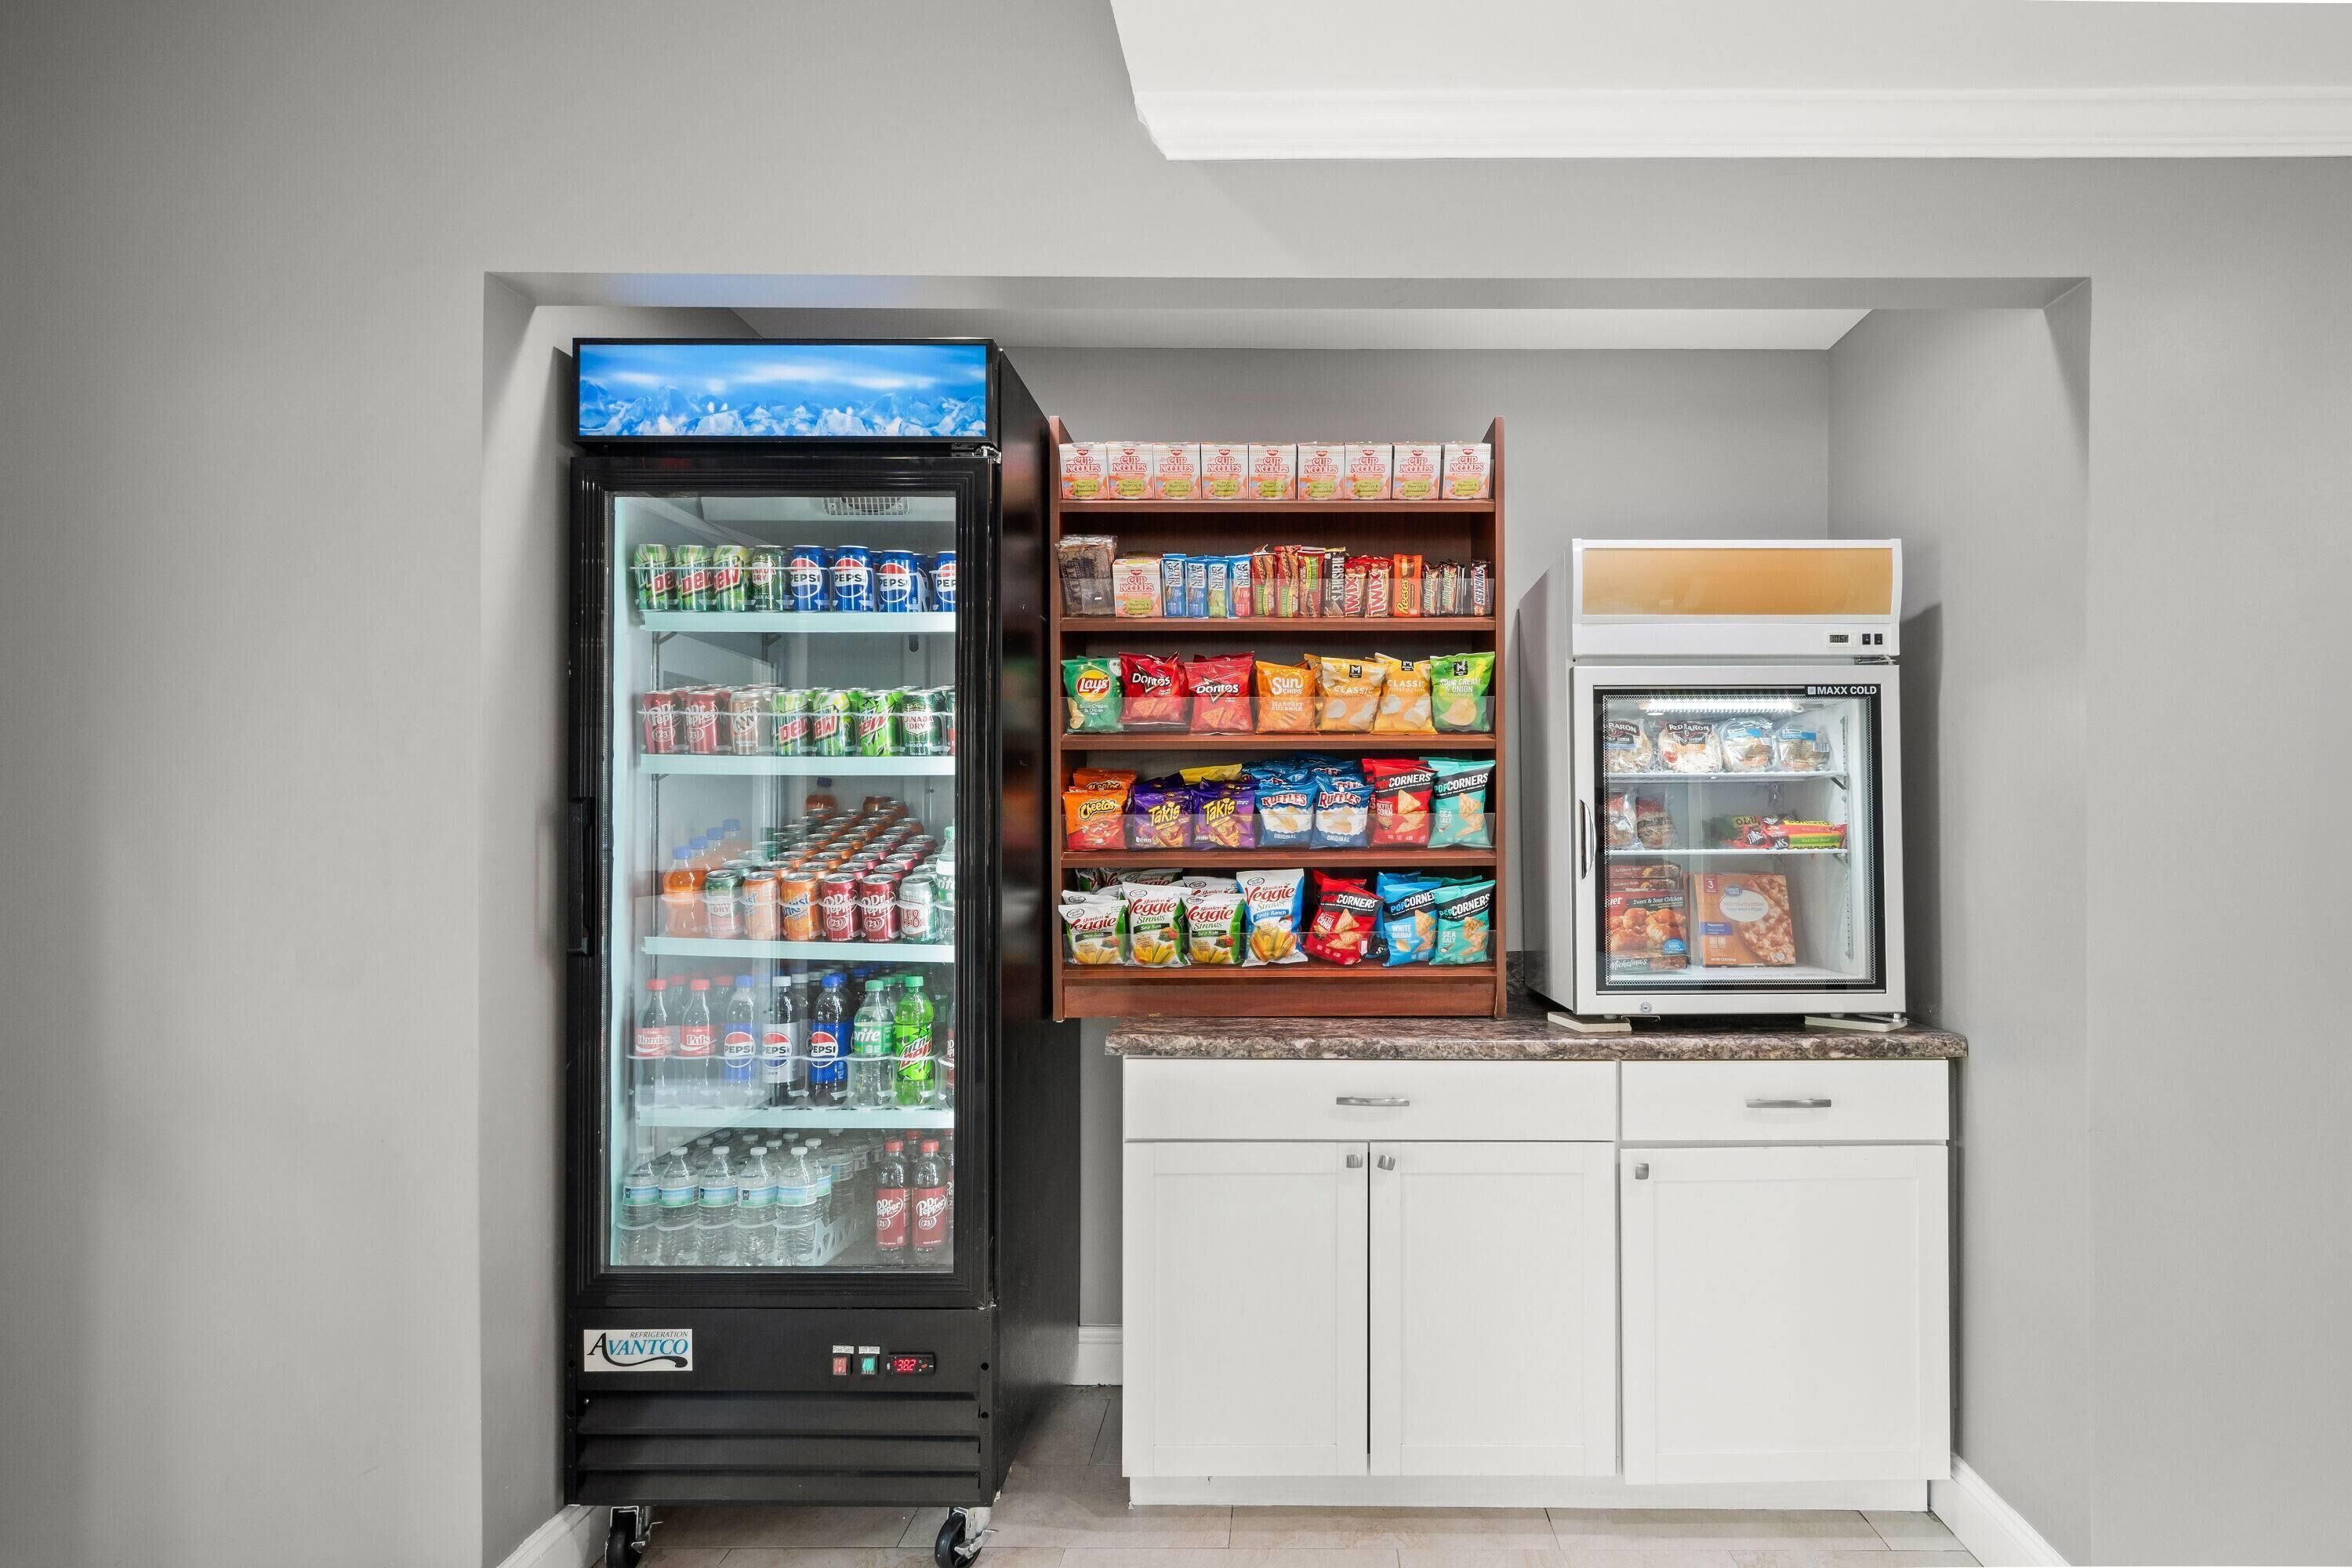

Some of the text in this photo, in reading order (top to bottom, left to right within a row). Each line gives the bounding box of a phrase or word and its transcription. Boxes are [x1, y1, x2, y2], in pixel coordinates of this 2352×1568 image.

[1120, 456, 1140, 464] CUP
[1263, 456, 1283, 465] CUP
[1359, 456, 1378, 465] CUP
[1408, 456, 1428, 465] CUP
[1066, 464, 1101, 473] NOODLES
[1112, 463, 1147, 472] NOODLES
[1160, 464, 1194, 473] NOODLES
[1207, 464, 1241, 473] NOODLES
[1255, 464, 1289, 473] NOODLES
[1305, 465, 1338, 474] NOODLES
[1351, 464, 1385, 473] NOODLES
[1399, 464, 1434, 473] NOODLES
[1450, 463, 1483, 472] NOODLES
[790, 573, 822, 583] PEPSI
[937, 579, 956, 588] PEP
[1120, 583, 1154, 592] NOODLES
[1474, 566, 1484, 604] SNICKERS
[1132, 673, 1171, 686] Doritos
[1196, 684, 1239, 694] Doritos
[1817, 686, 1877, 695] MAXX COLD
[1608, 722, 1637, 733] BARON
[1684, 723, 1709, 731] BARON
[1317, 791, 1362, 808] RUFFLES
[1080, 799, 1116, 819] Cheetos
[1203, 797, 1236, 825] Takis
[1377, 808, 1393, 817] CORN
[1148, 802, 1181, 827] Takis
[1327, 834, 1351, 843] ORIGINAL
[1708, 880, 1714, 889] 3
[1244, 886, 1294, 906] Veggie
[1256, 901, 1285, 912] Straws
[1390, 891, 1435, 913] POPCORNE
[1127, 898, 1177, 916] Veggie
[1187, 905, 1235, 923] Veggie
[1070, 916, 1117, 931] Veggie
[1193, 922, 1222, 931] Straws
[637, 1034, 671, 1045] Homies
[687, 1034, 711, 1046] Pals
[725, 1045, 754, 1054] PEPSI
[812, 1045, 837, 1054] EPSI
[586, 1331, 689, 1366] AVANTCO
